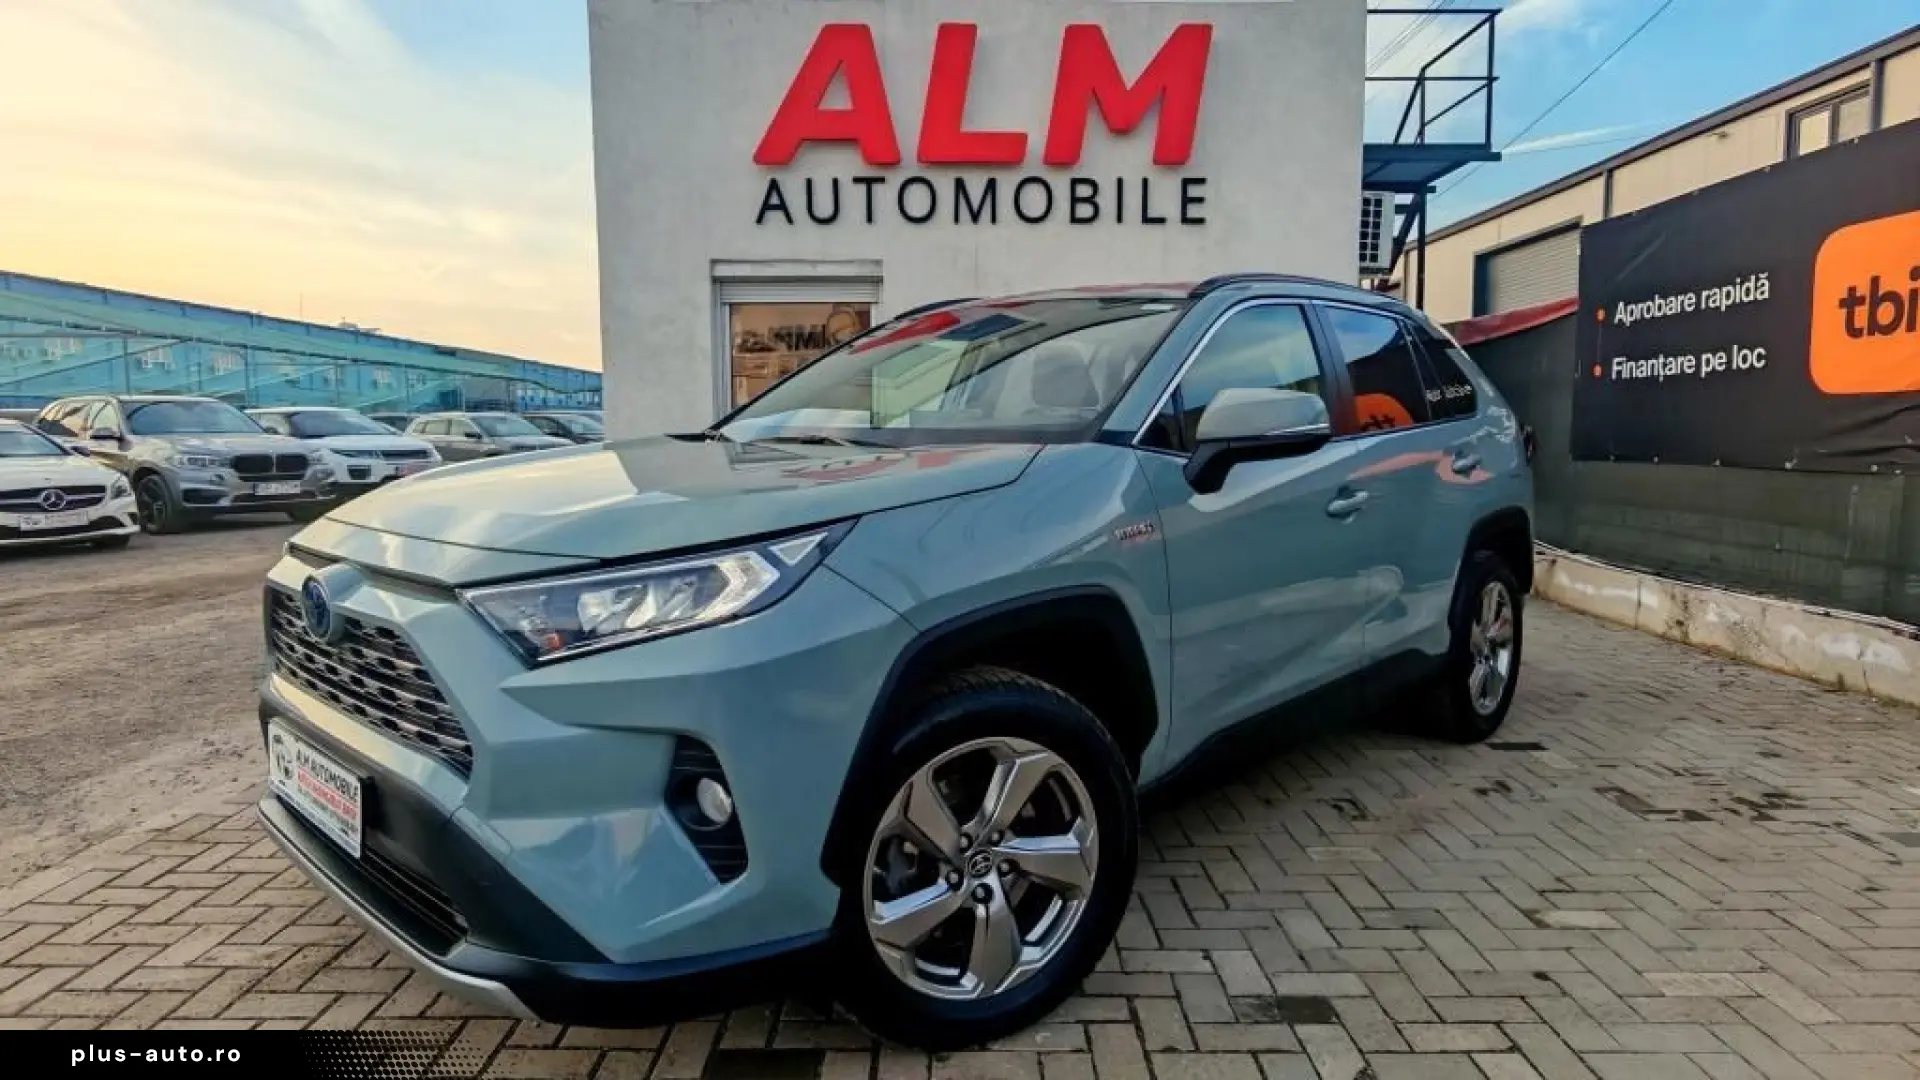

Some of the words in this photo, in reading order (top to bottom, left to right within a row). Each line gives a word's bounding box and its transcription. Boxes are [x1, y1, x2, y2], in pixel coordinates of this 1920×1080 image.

[753, 23, 1213, 167] ALM
[756, 176, 1207, 225] AUTOMOBILE
[1613, 294, 1697, 327] Aprobare
[1700, 272, 1771, 312] rapidă
[1700, 350, 1728, 378] pe
[1731, 344, 1767, 370] loc
